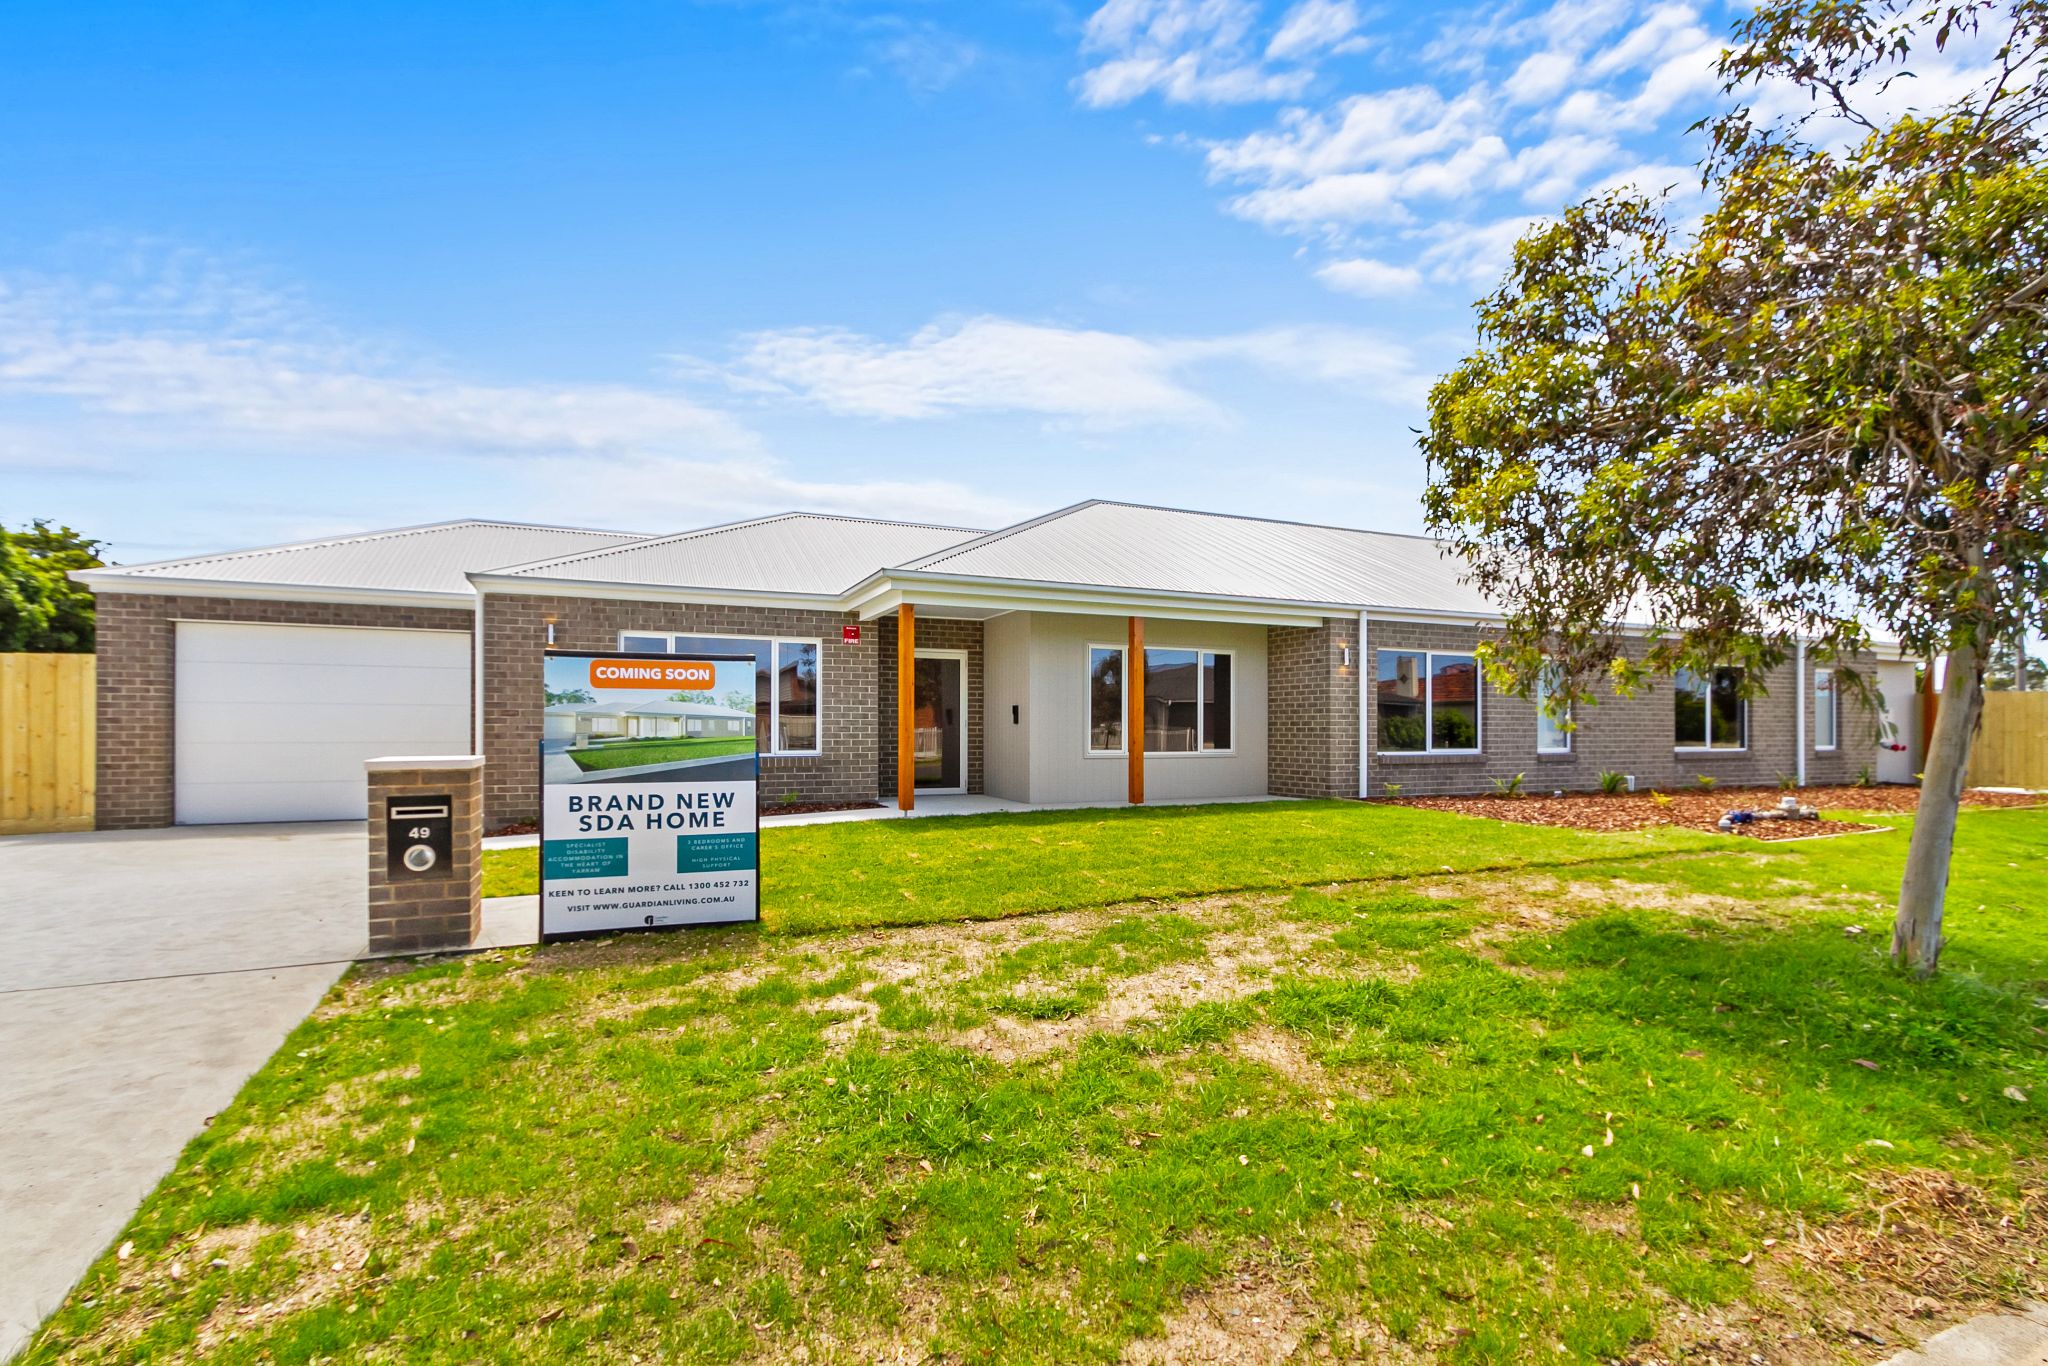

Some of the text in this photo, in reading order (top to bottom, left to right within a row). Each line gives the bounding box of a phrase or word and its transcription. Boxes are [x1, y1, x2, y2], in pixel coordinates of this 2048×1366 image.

[595, 666, 710, 681] COMING SOON
[568, 792, 735, 813] BRAND NEW
[579, 811, 726, 832] SDA HOME
[408, 827, 431, 839] 49
[547, 854, 614, 862] ACCOMMODATION
[548, 879, 749, 898] KEEN TO LEARN MORE? CALL 1300 452 732
[567, 896, 736, 912] VISIT WWW.GUARDIANLIVING.COM.AU
